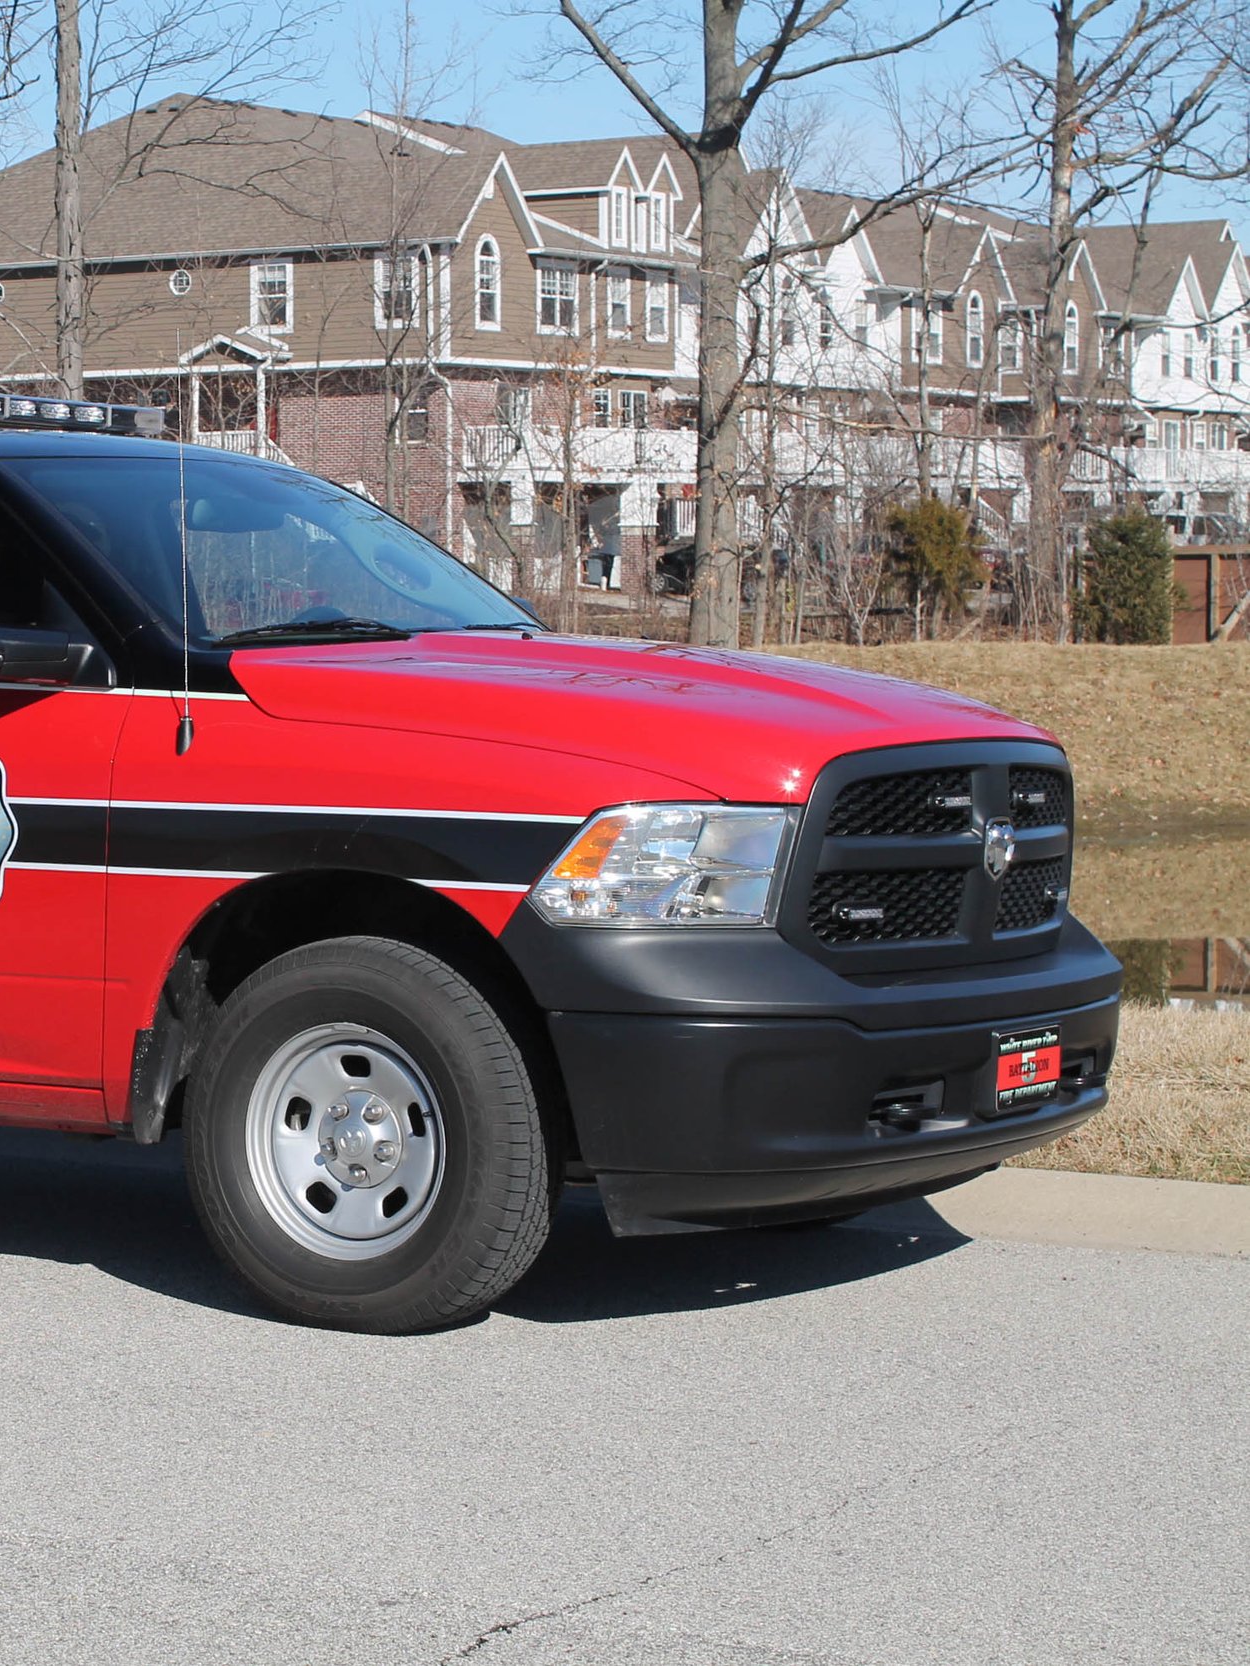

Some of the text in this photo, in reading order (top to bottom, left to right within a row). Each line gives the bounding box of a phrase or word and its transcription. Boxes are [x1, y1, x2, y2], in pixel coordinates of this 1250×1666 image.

[1008, 1057, 1050, 1078] BATTALION
[1021, 1051, 1037, 1083] 5
[1014, 1080, 1057, 1098] DEPARTMENT
